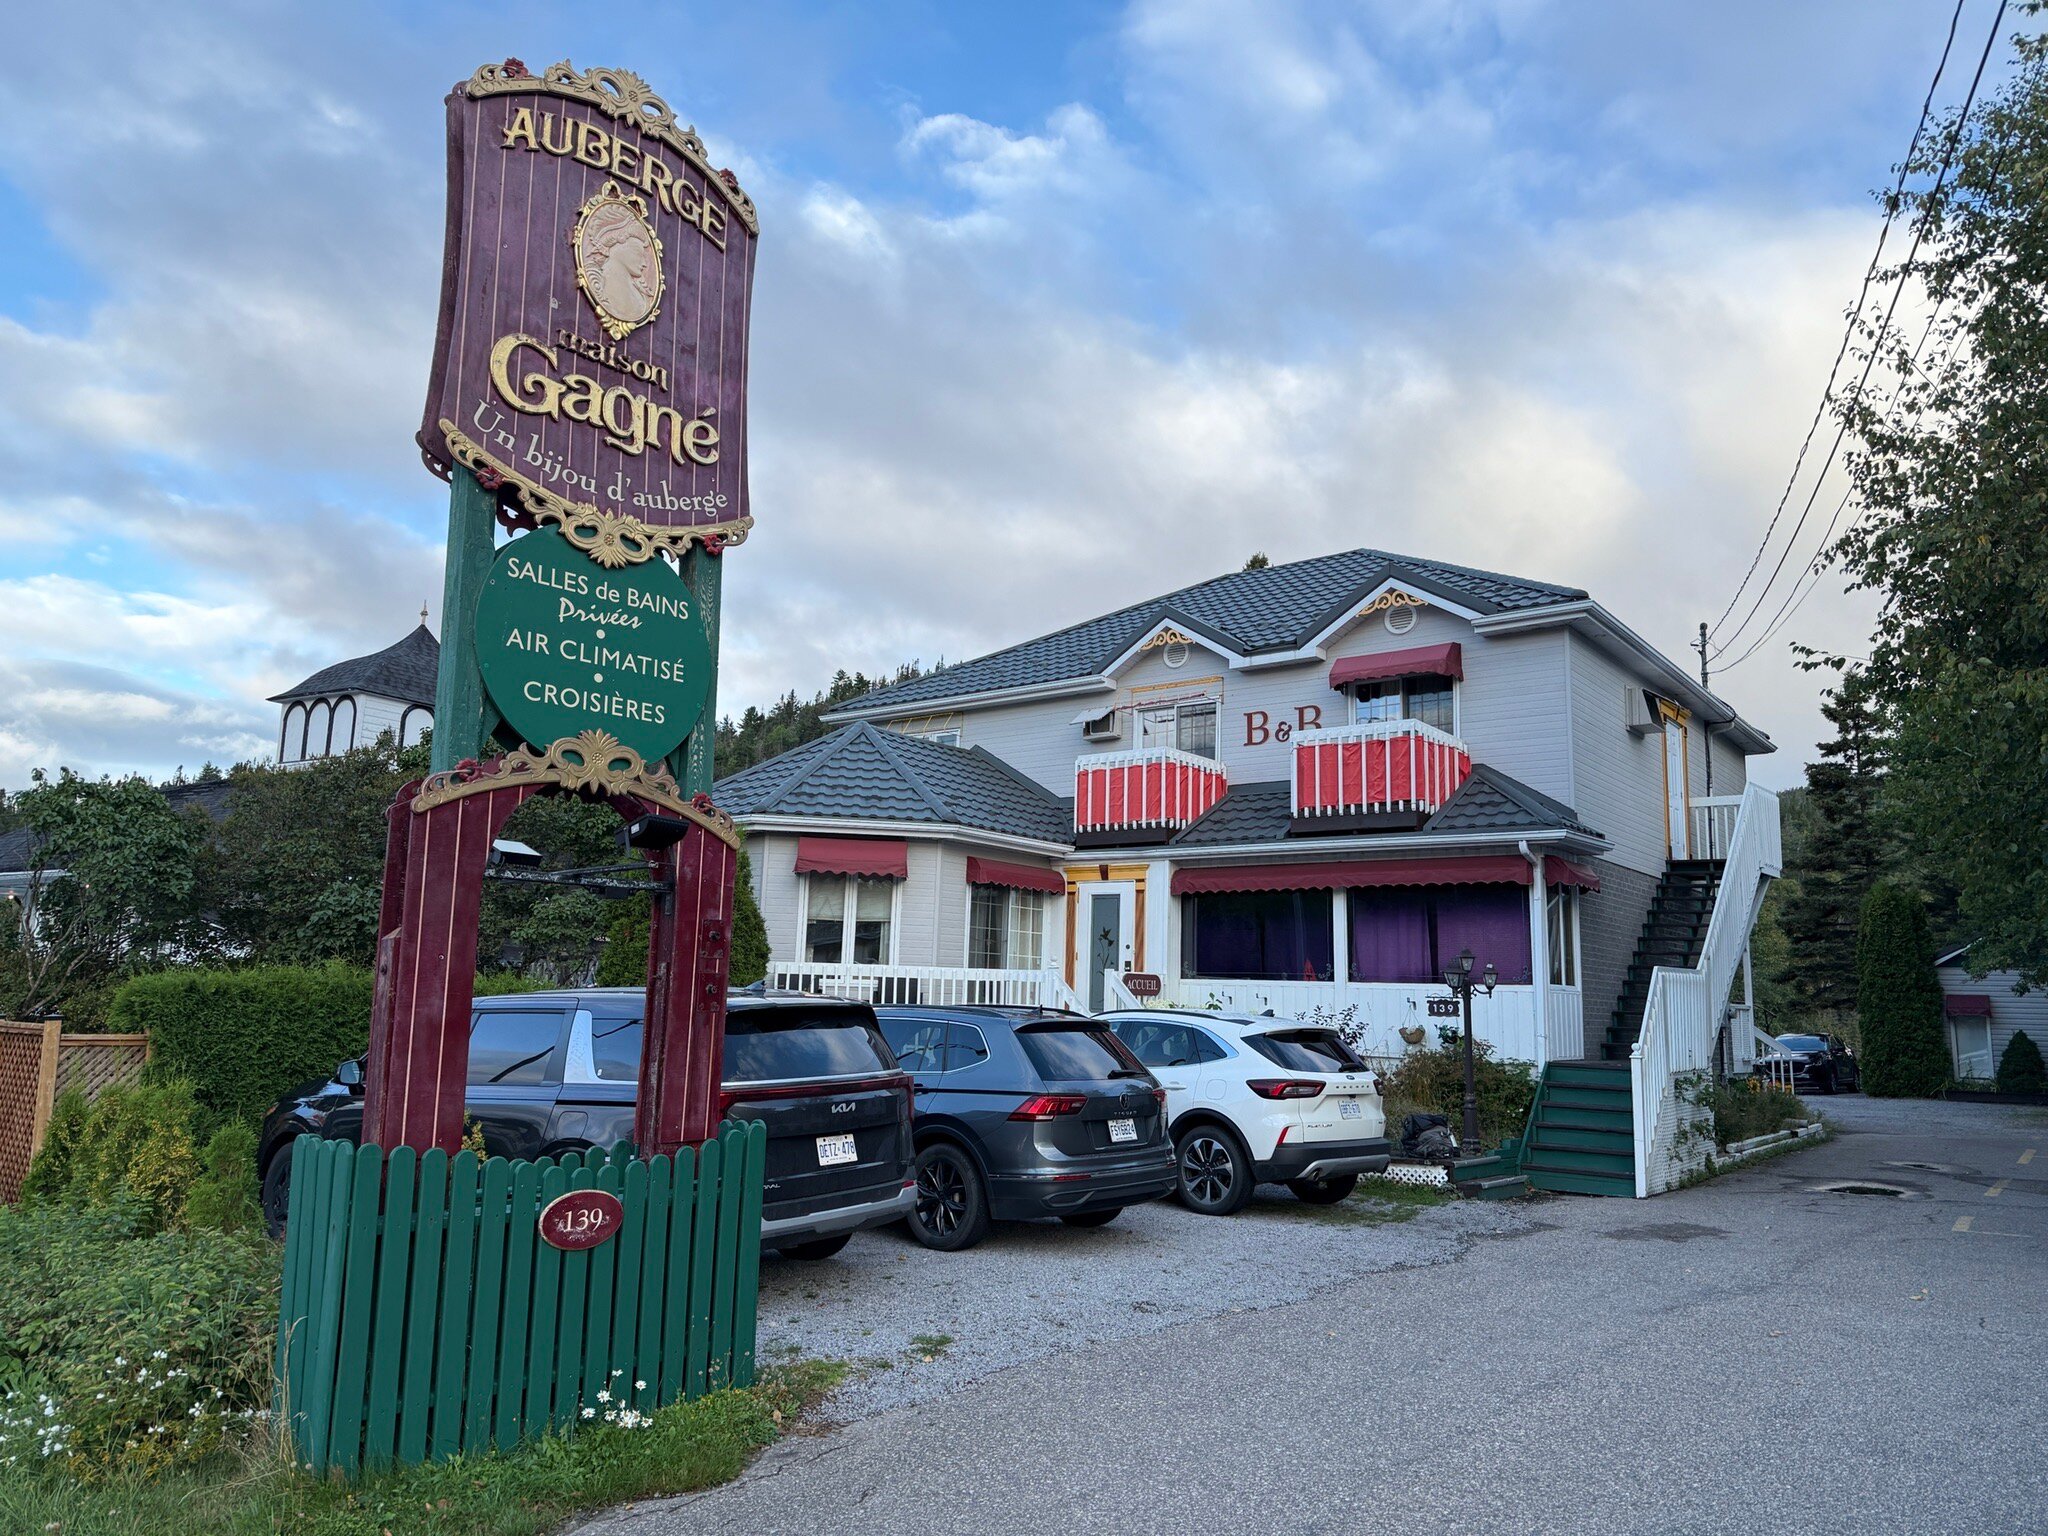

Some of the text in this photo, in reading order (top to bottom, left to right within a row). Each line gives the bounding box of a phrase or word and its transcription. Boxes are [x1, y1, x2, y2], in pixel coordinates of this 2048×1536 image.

[501, 107, 728, 252] AUBERGE
[556, 328, 669, 391] maison
[489, 332, 721, 466] Gagné
[472, 398, 515, 452] Un
[522, 433, 598, 494] bijou
[507, 557, 689, 621] SALLES de BAINS
[558, 596, 643, 630] Privées
[505, 628, 685, 684] AIR CLIMATISÉ
[523, 680, 666, 725] CROISIÈRES
[1127, 978, 1158, 991] ACCUEIL
[1432, 1003, 1454, 1013] 139
[831, 1102, 856, 1113] KIA
[564, 1207, 603, 1233] 139
